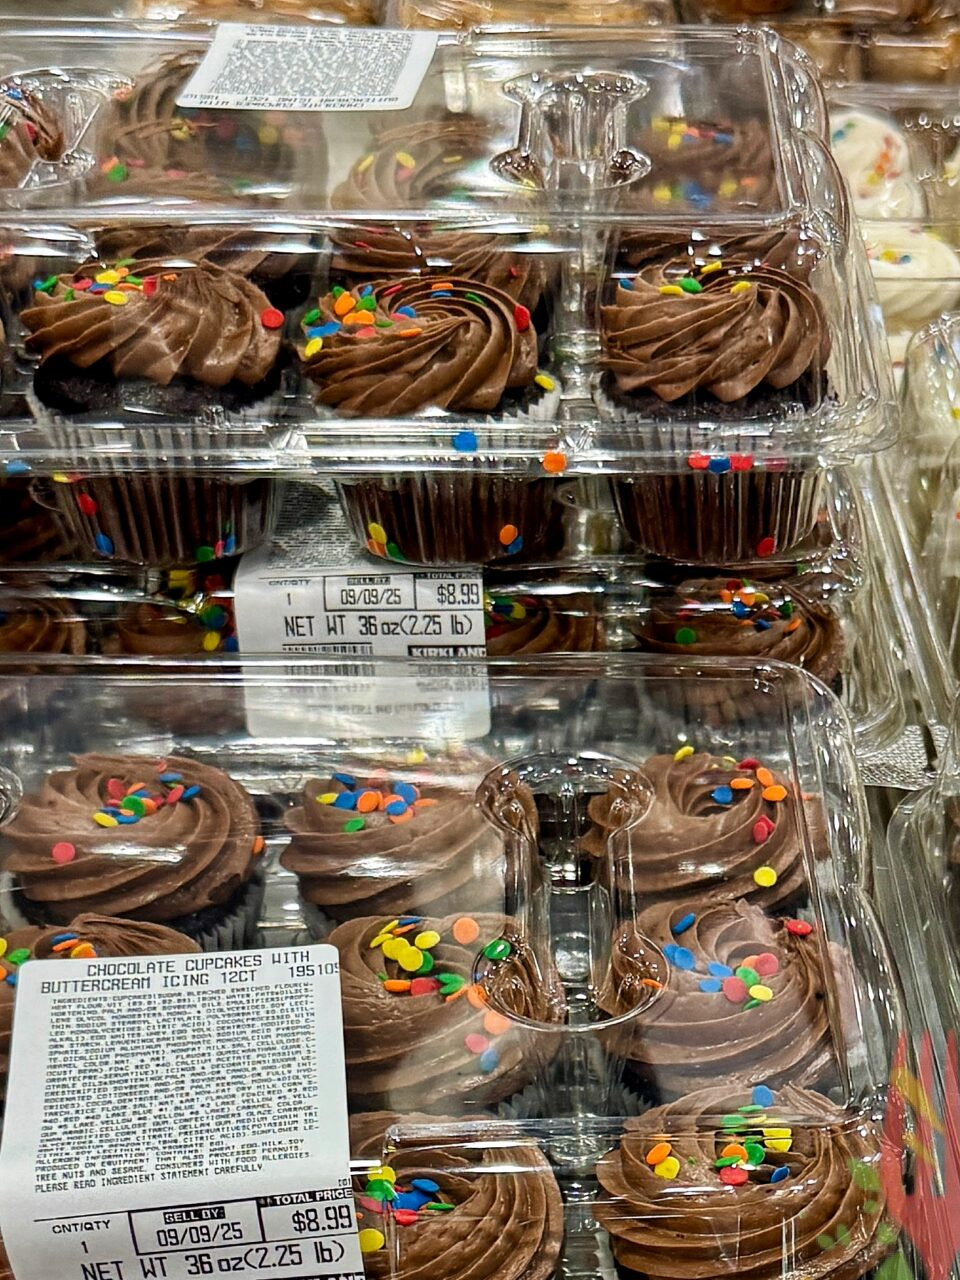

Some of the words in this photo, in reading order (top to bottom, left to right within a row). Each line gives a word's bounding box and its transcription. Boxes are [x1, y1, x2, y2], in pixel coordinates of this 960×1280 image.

[340, 589, 401, 605] 09/09/25
[437, 583, 480, 604] $8.99
[285, 616, 314, 636] NET
[327, 616, 346, 634] WT
[450, 615, 473, 635] lb)
[87, 960, 175, 977] CHOCOLATE
[184, 954, 262, 970] CUPCAKES
[271, 950, 310, 964] WITH
[40, 977, 151, 994] BUTTERCREAM
[163, 972, 208, 987] ICING
[221, 970, 256, 984] 12CT
[34, 1182, 67, 1192] PLEASE
[73, 1179, 95, 1188] READ
[160, 1168, 208, 1180] STATEMENT
[35, 1173, 56, 1181] TREE
[62, 1170, 84, 1179] NUTS
[90, 1168, 106, 1176] AND
[209, 1158, 229, 1166] WITH
[236, 1156, 256, 1164] FOOD
[274, 1192, 314, 1205] TOTAL
[315, 1188, 352, 1200] PRICE
[52, 1218, 111, 1234] CNT/QTY
[164, 1210, 199, 1223] SELL
[81, 1240, 88, 1254] 1
[156, 1221, 243, 1248] 09/09/25
[290, 1204, 353, 1234] $8.99
[141, 1256, 168, 1279] WT
[313, 1238, 346, 1263] lb)
